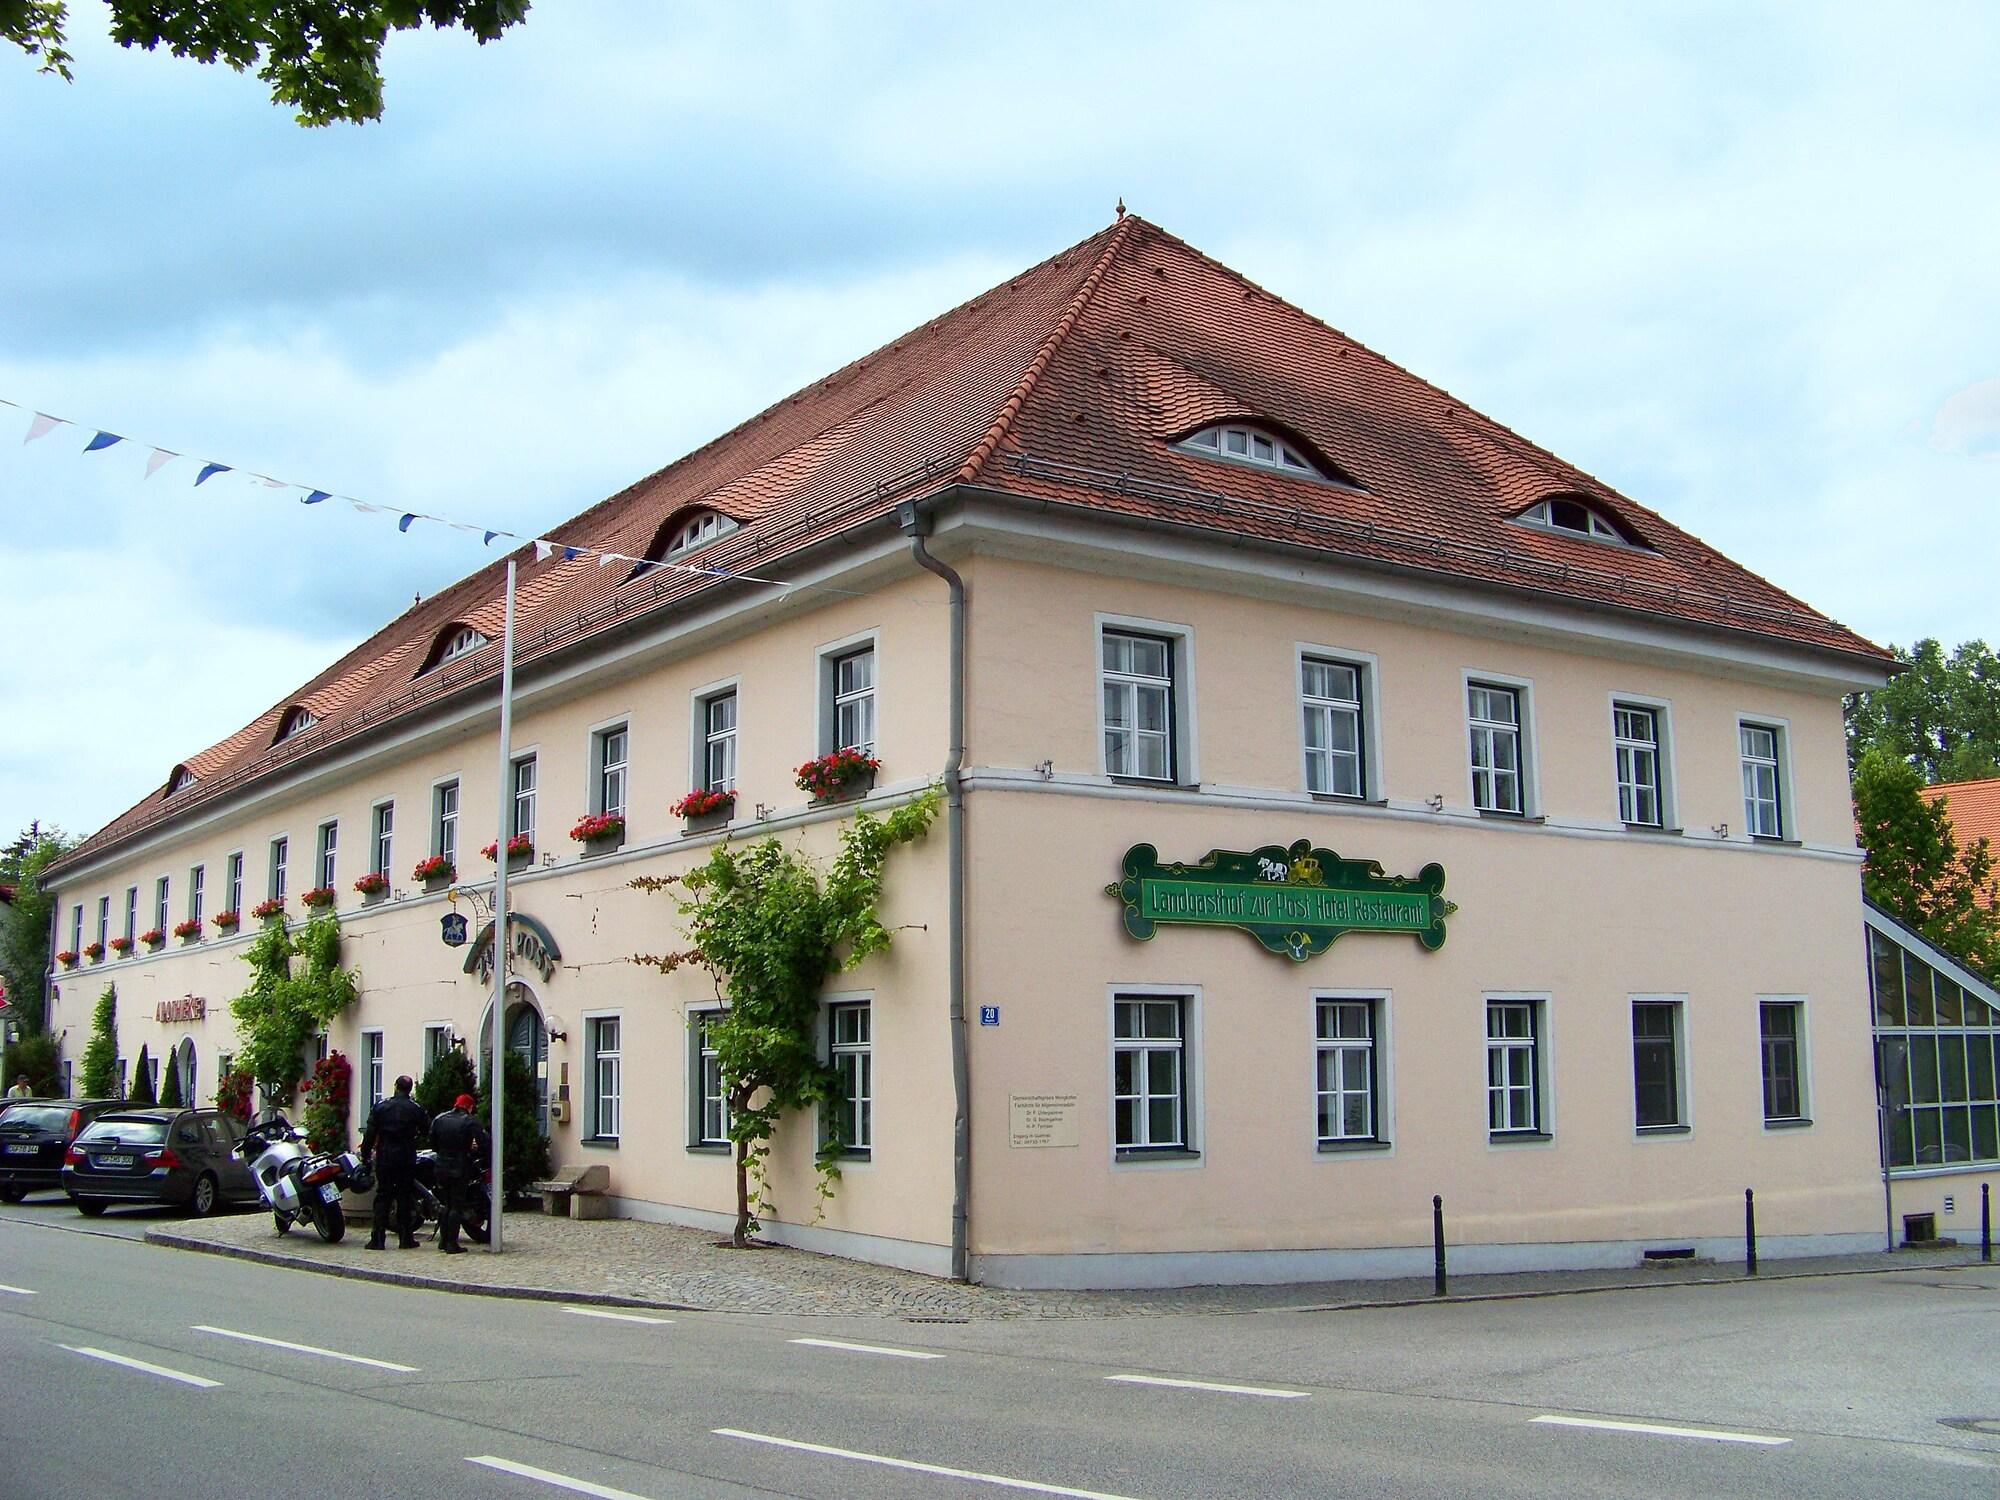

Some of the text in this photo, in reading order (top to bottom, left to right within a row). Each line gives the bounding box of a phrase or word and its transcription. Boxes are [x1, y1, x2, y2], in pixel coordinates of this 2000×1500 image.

[1152, 884, 1424, 925] Landgasthof zur Post Hotel Restaurant
[514, 931, 555, 983] POST
[985, 1008, 995, 1019] 20
